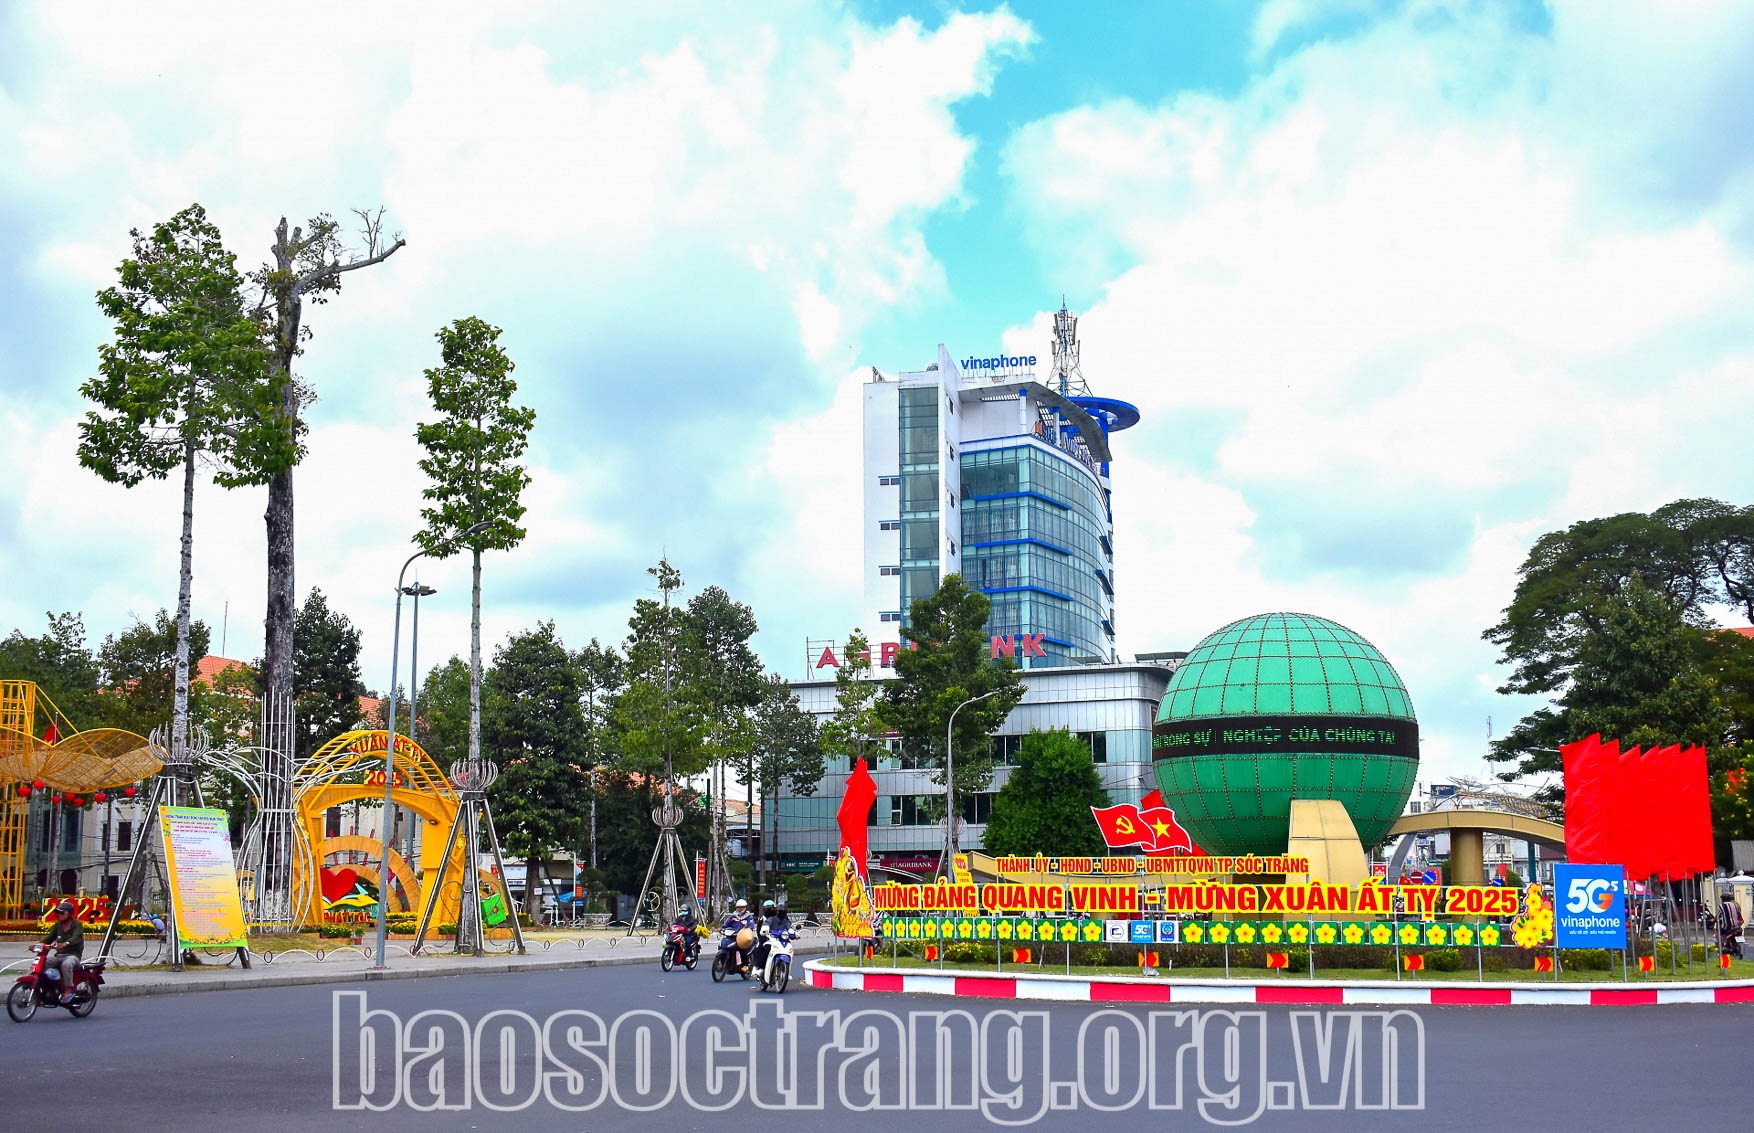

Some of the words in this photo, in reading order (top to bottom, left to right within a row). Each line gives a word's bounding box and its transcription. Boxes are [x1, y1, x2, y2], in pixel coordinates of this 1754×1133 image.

[960, 354, 1037, 370] vinaphone
[816, 633, 1048, 668] AGRNK
[1288, 725, 1321, 742] CỦA
[1324, 726, 1375, 742] CHÚNG
[367, 769, 404, 787] 205
[996, 853, 1031, 873] THÀNH
[1033, 851, 1050, 874] ỦY
[1059, 857, 1092, 874] HĐND
[1102, 857, 1136, 874] UBND
[1146, 857, 1214, 875] UBMTTQVN
[1215, 857, 1233, 873] TP
[1236, 854, 1263, 873] SÓC
[1265, 854, 1309, 873] TRĂNG
[874, 882, 920, 909] MỪNG
[923, 877, 977, 909] ĐẢNG
[983, 884, 1064, 912] QUANG
[1071, 886, 1137, 911] VINH
[1167, 879, 1258, 911] MỪNG
[1264, 881, 1349, 912] XUÂN
[1356, 877, 1395, 912] ẤT
[1402, 886, 1440, 919] TỴ
[1448, 888, 1518, 914] 2025
[1561, 915, 1620, 929] vinaphone
